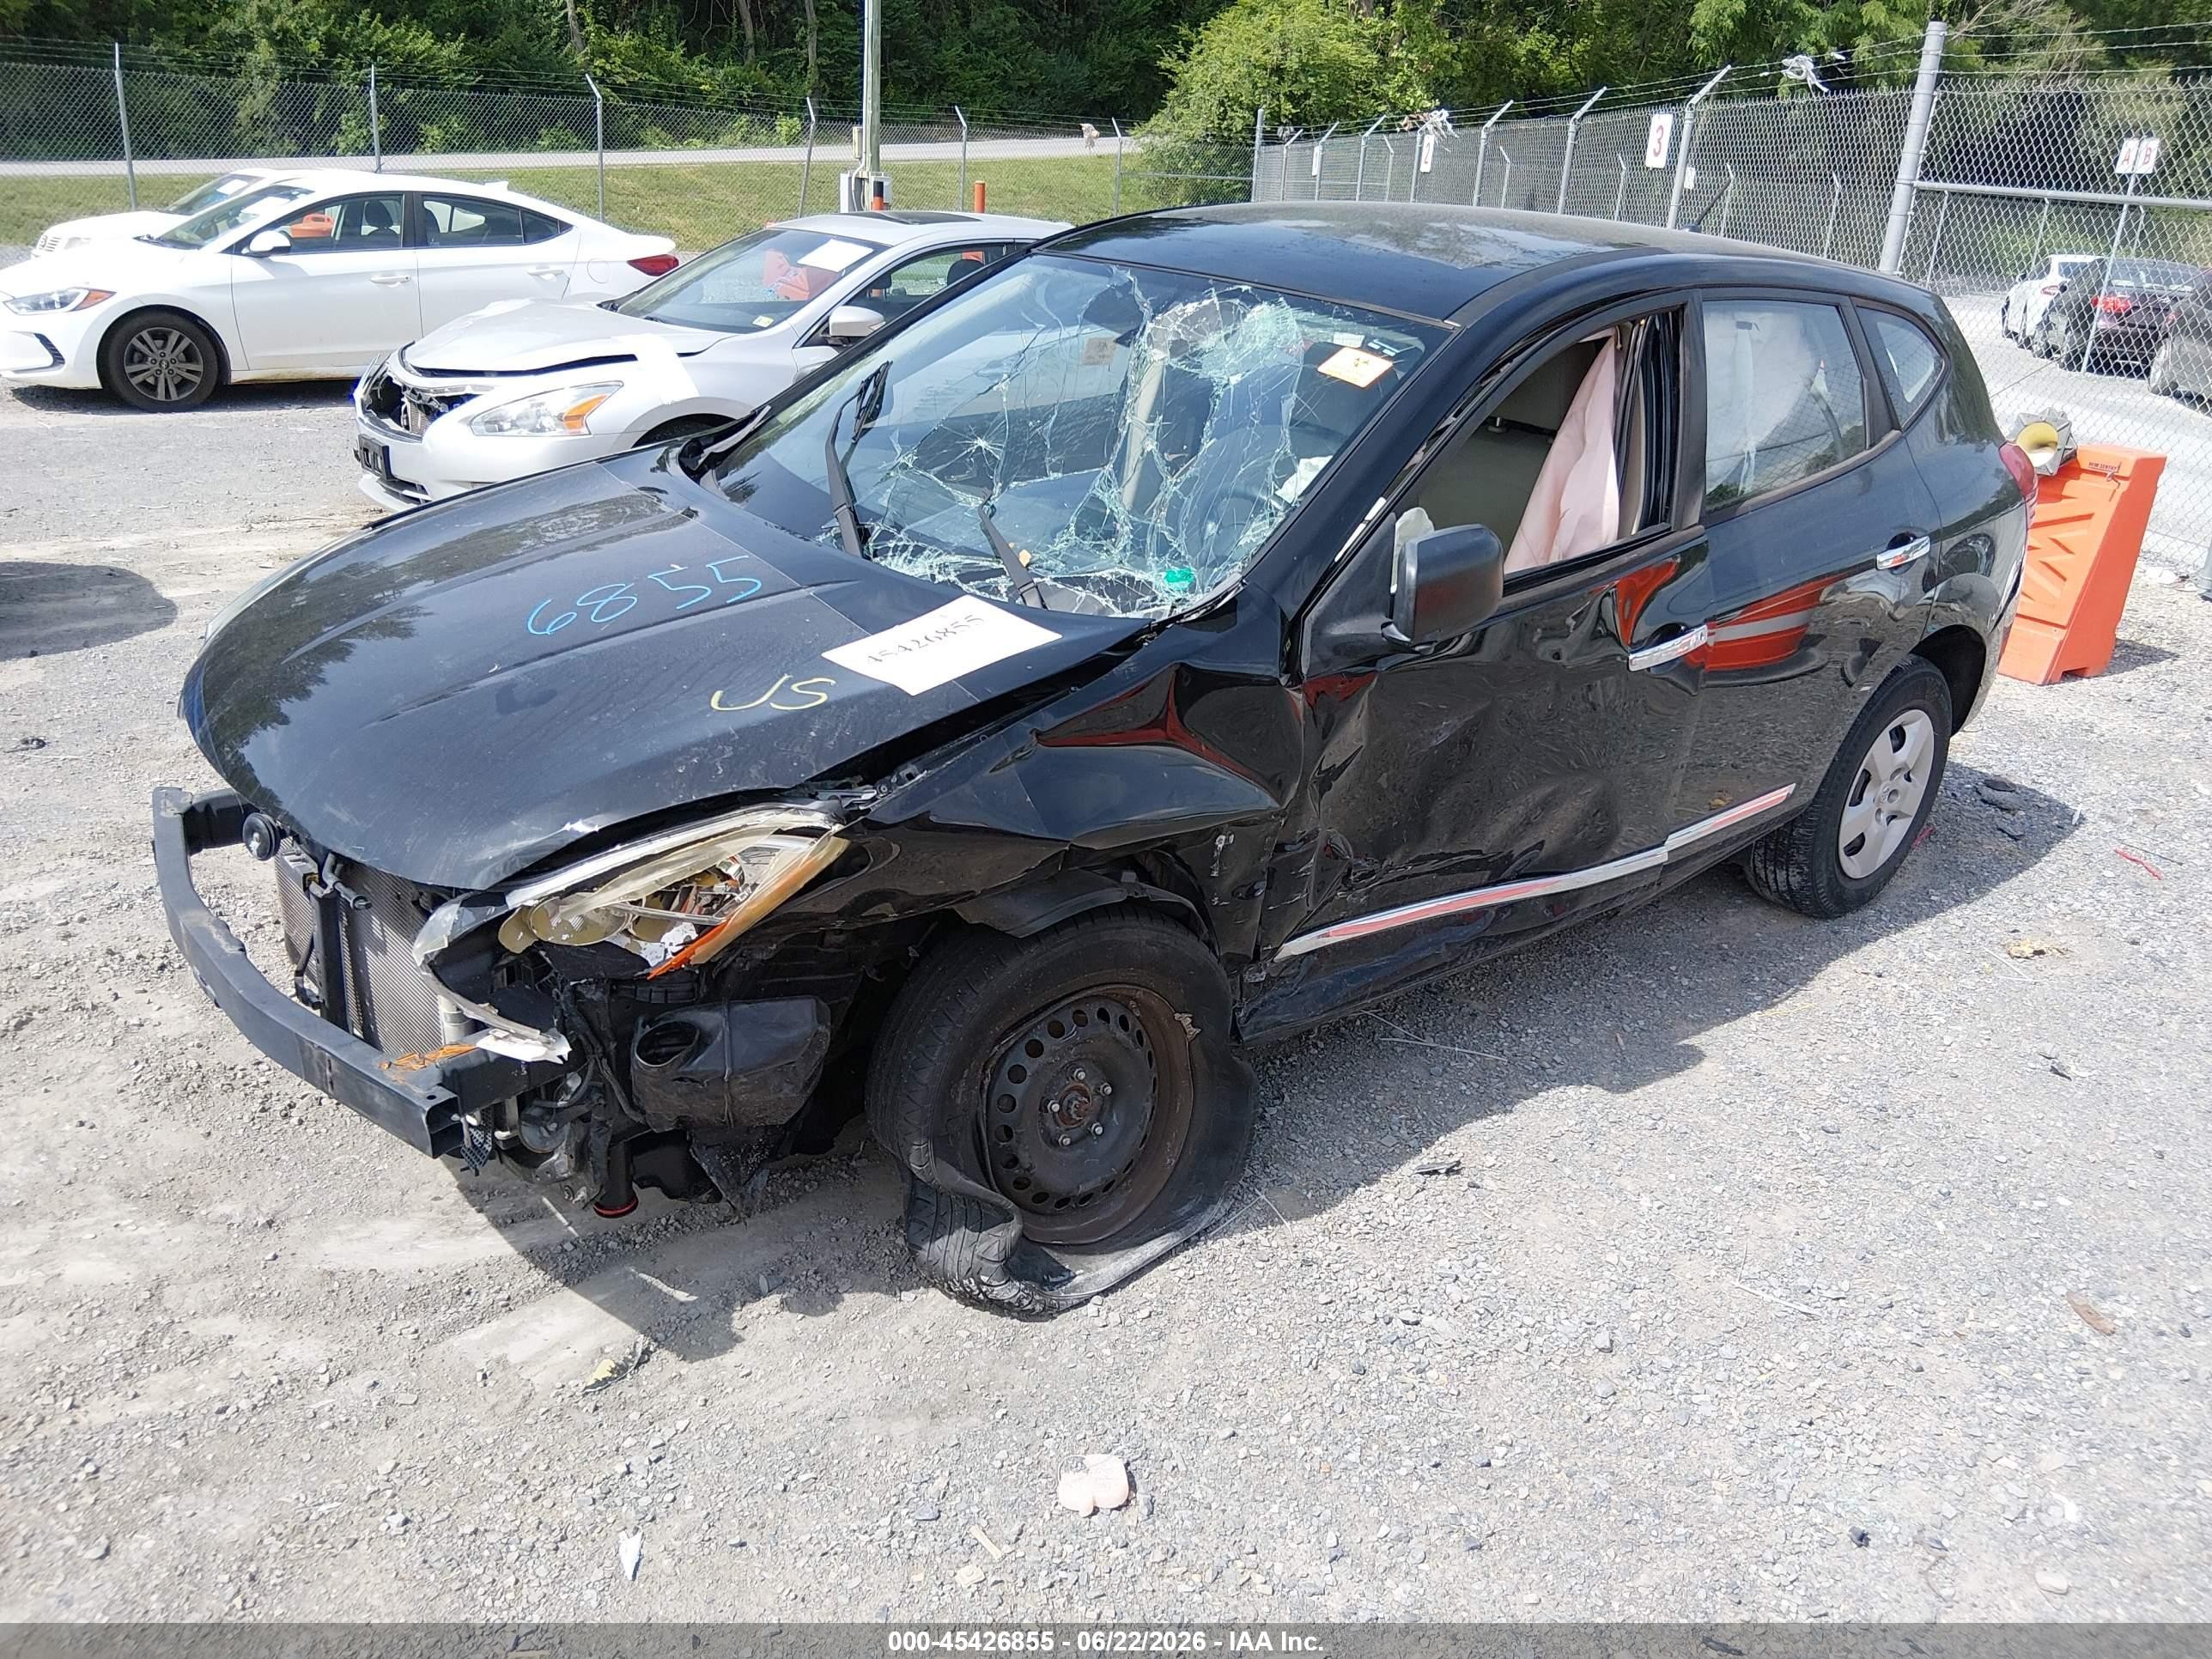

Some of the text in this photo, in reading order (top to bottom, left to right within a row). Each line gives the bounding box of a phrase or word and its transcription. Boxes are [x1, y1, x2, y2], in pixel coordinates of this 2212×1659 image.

[1424, 142, 1431, 164] 2
[1652, 125, 1664, 157] 3
[2121, 147, 2152, 166] A B
[526, 555, 763, 635] 6855
[710, 672, 837, 711] US
